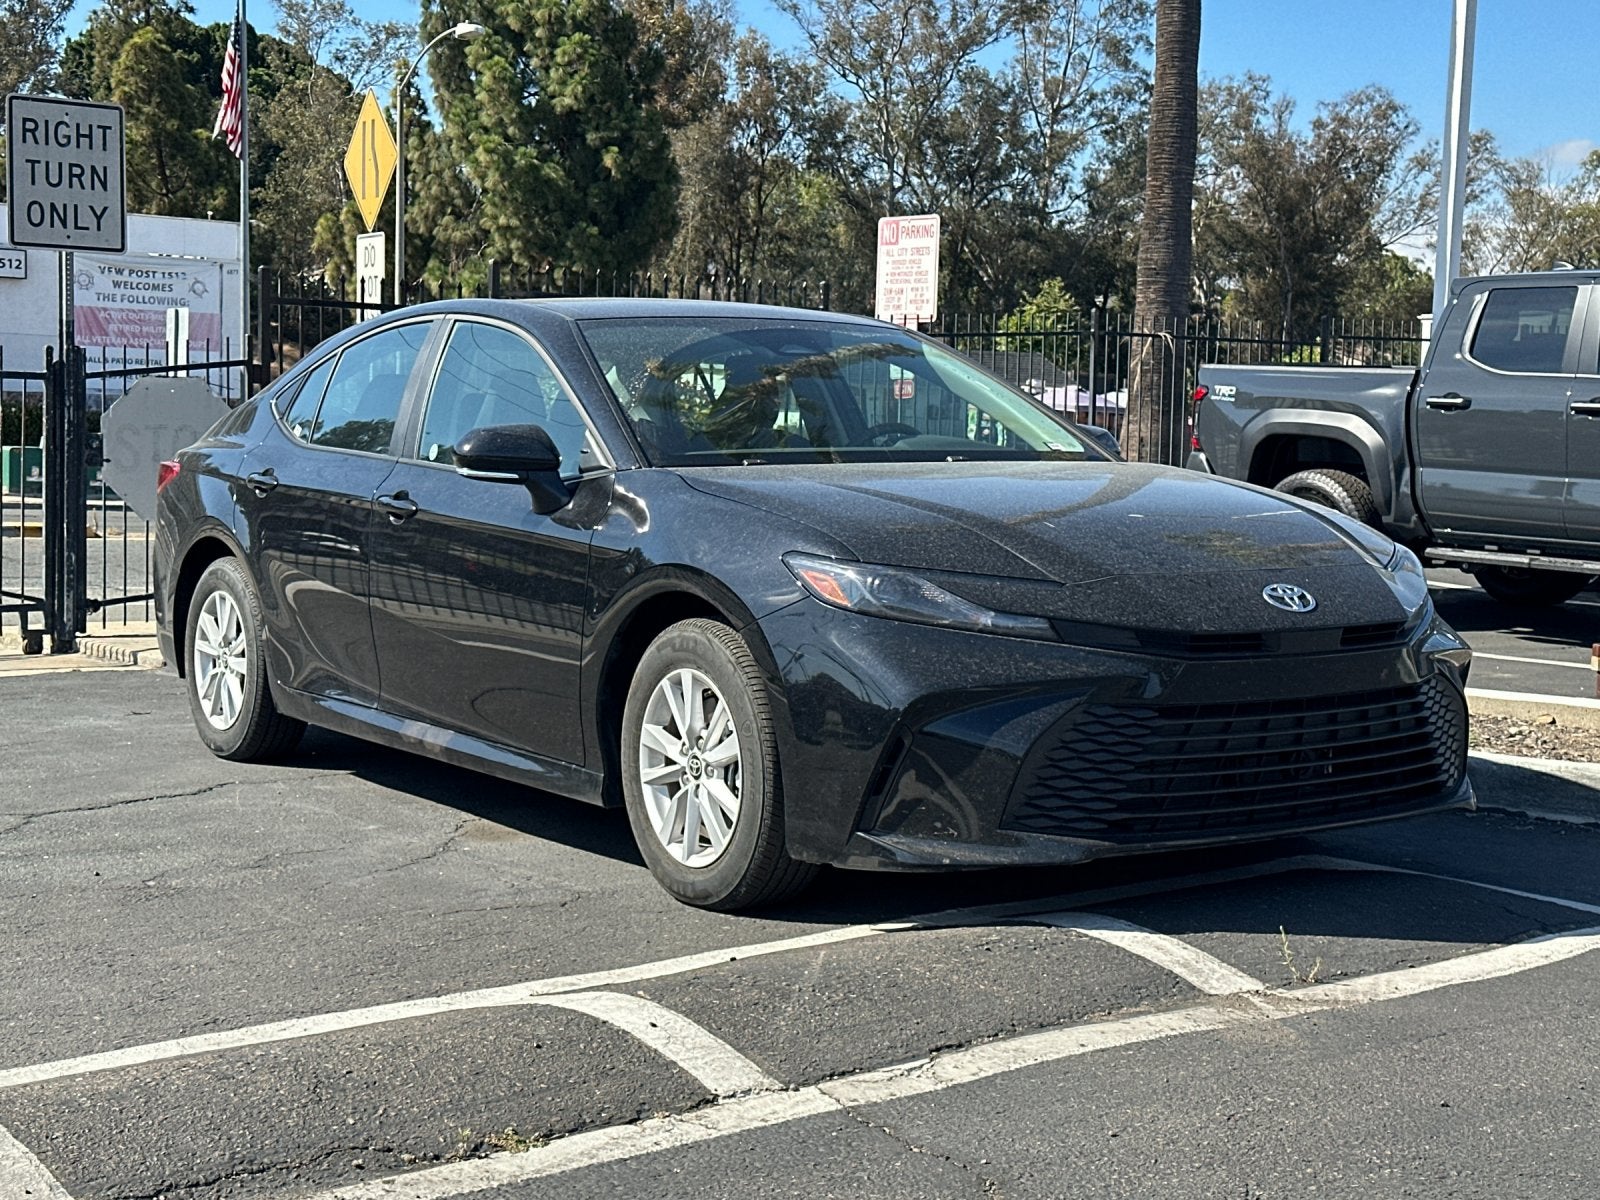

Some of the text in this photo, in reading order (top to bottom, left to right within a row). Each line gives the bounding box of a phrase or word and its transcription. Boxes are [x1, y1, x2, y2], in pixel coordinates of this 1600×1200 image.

[21, 117, 113, 151] RIGHT
[25, 158, 108, 192] TURN
[26, 200, 109, 232] ONLY
[883, 223, 935, 243] NO PARKING
[364, 245, 376, 268] DO
[98, 265, 187, 280] VFW POST 1512
[112, 280, 174, 292] WELCOMES
[95, 292, 190, 307] THE FOLLOWING:
[108, 324, 166, 334] RETIRED MILITA
[76, 335, 91, 344] ALL
[129, 338, 166, 347] ASSOCIAT
[111, 357, 133, 365] PATO
